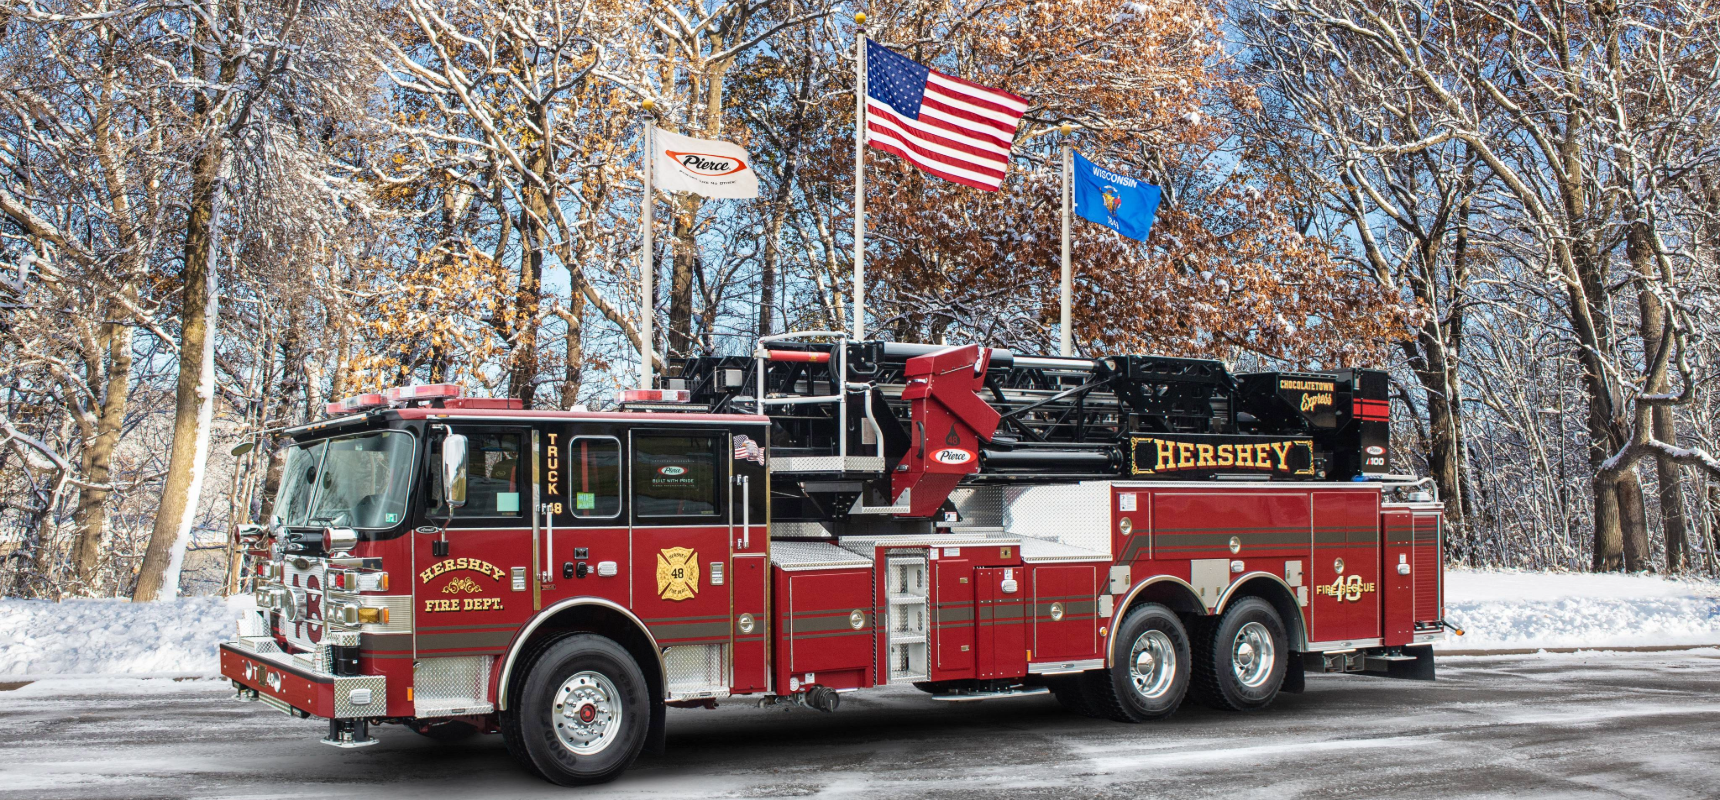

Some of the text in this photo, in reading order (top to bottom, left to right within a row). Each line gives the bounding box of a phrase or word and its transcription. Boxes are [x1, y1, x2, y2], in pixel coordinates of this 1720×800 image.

[683, 155, 730, 171] Pierce
[1093, 167, 1137, 188] WISCONSIN
[1280, 380, 1334, 392] CHOCOLATETOWN
[1301, 393, 1332, 412] Express
[940, 450, 965, 461] Pierce
[1154, 438, 1292, 471] HERSHEY
[547, 433, 559, 495] TRUCK
[420, 557, 506, 584] HERSHEY
[671, 568, 684, 579] 48
[1316, 585, 1338, 594] FIRE
[425, 598, 504, 612] FIRE DEPT.
